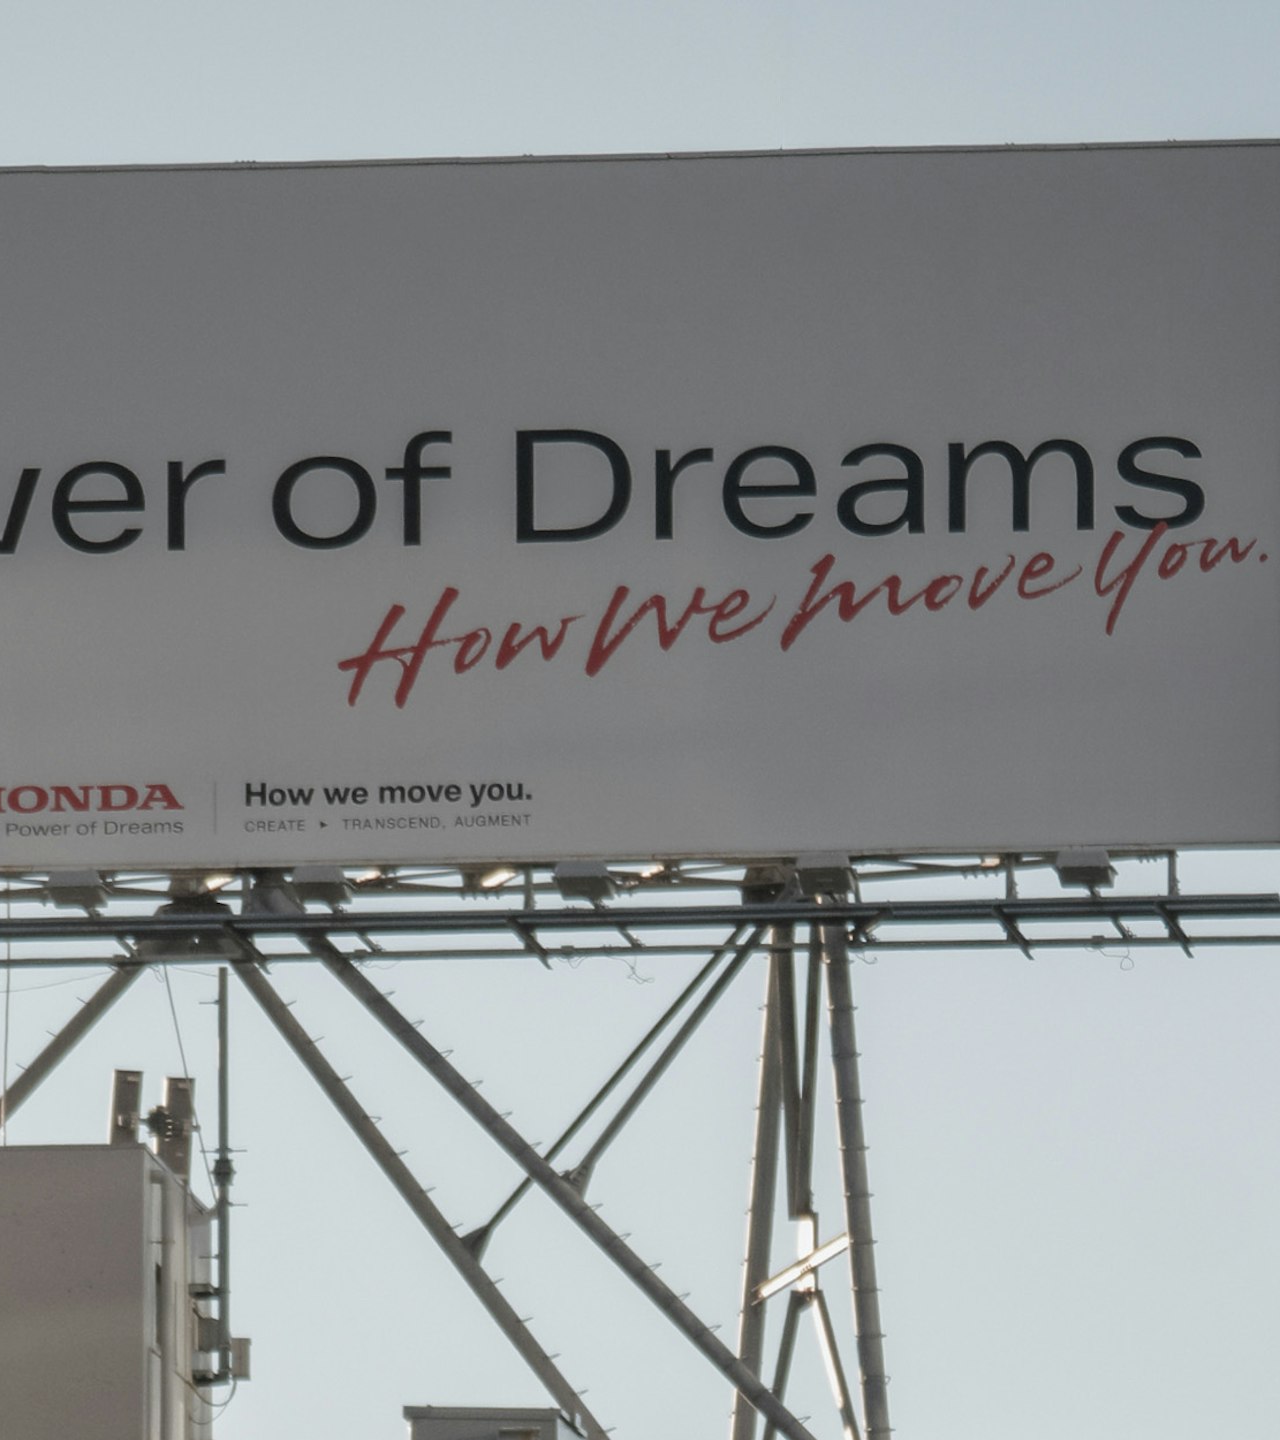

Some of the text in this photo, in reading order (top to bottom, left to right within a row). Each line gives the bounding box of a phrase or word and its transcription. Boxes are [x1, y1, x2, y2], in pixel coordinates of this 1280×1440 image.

[272, 429, 452, 550] of
[514, 428, 1205, 543] Dreams
[337, 586, 586, 709] How
[244, 783, 314, 807] How
[323, 787, 368, 805] we
[379, 785, 460, 804] move
[469, 783, 532, 808] you.
[6, 822, 70, 837] Power
[76, 820, 98, 836] of
[104, 819, 184, 835] Dreams
[244, 819, 306, 833] CREATE
[454, 814, 532, 829] AUGMENT
